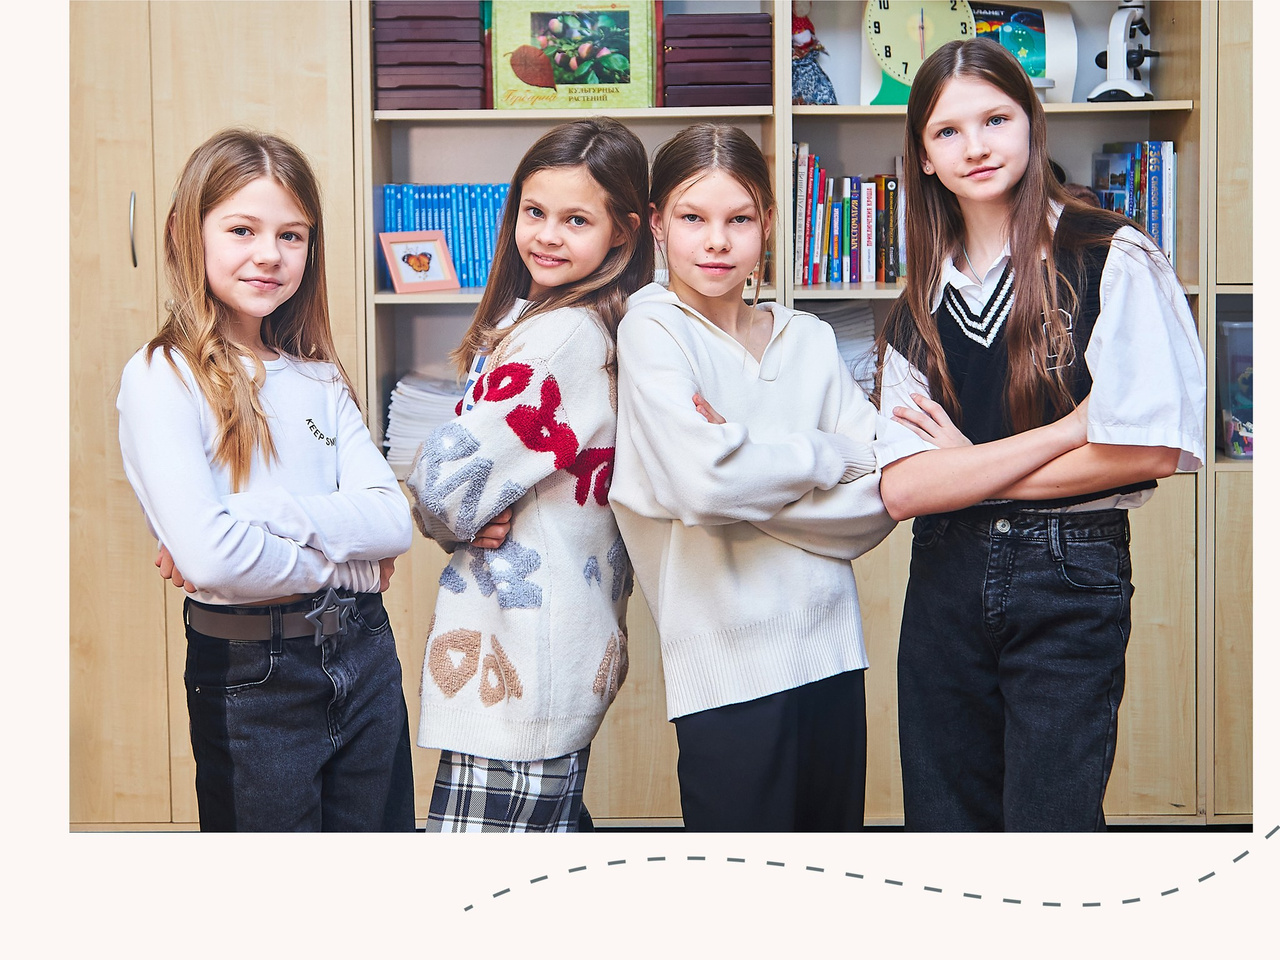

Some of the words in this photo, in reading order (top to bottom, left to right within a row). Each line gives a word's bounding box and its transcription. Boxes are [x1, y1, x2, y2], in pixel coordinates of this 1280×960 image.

[874, 21, 880, 34] 9
[961, 23, 967, 34] 3
[885, 46, 892, 58] 8
[902, 62, 908, 74] 7
[1150, 150, 1160, 172] 365
[306, 419, 324, 441] KEEP
